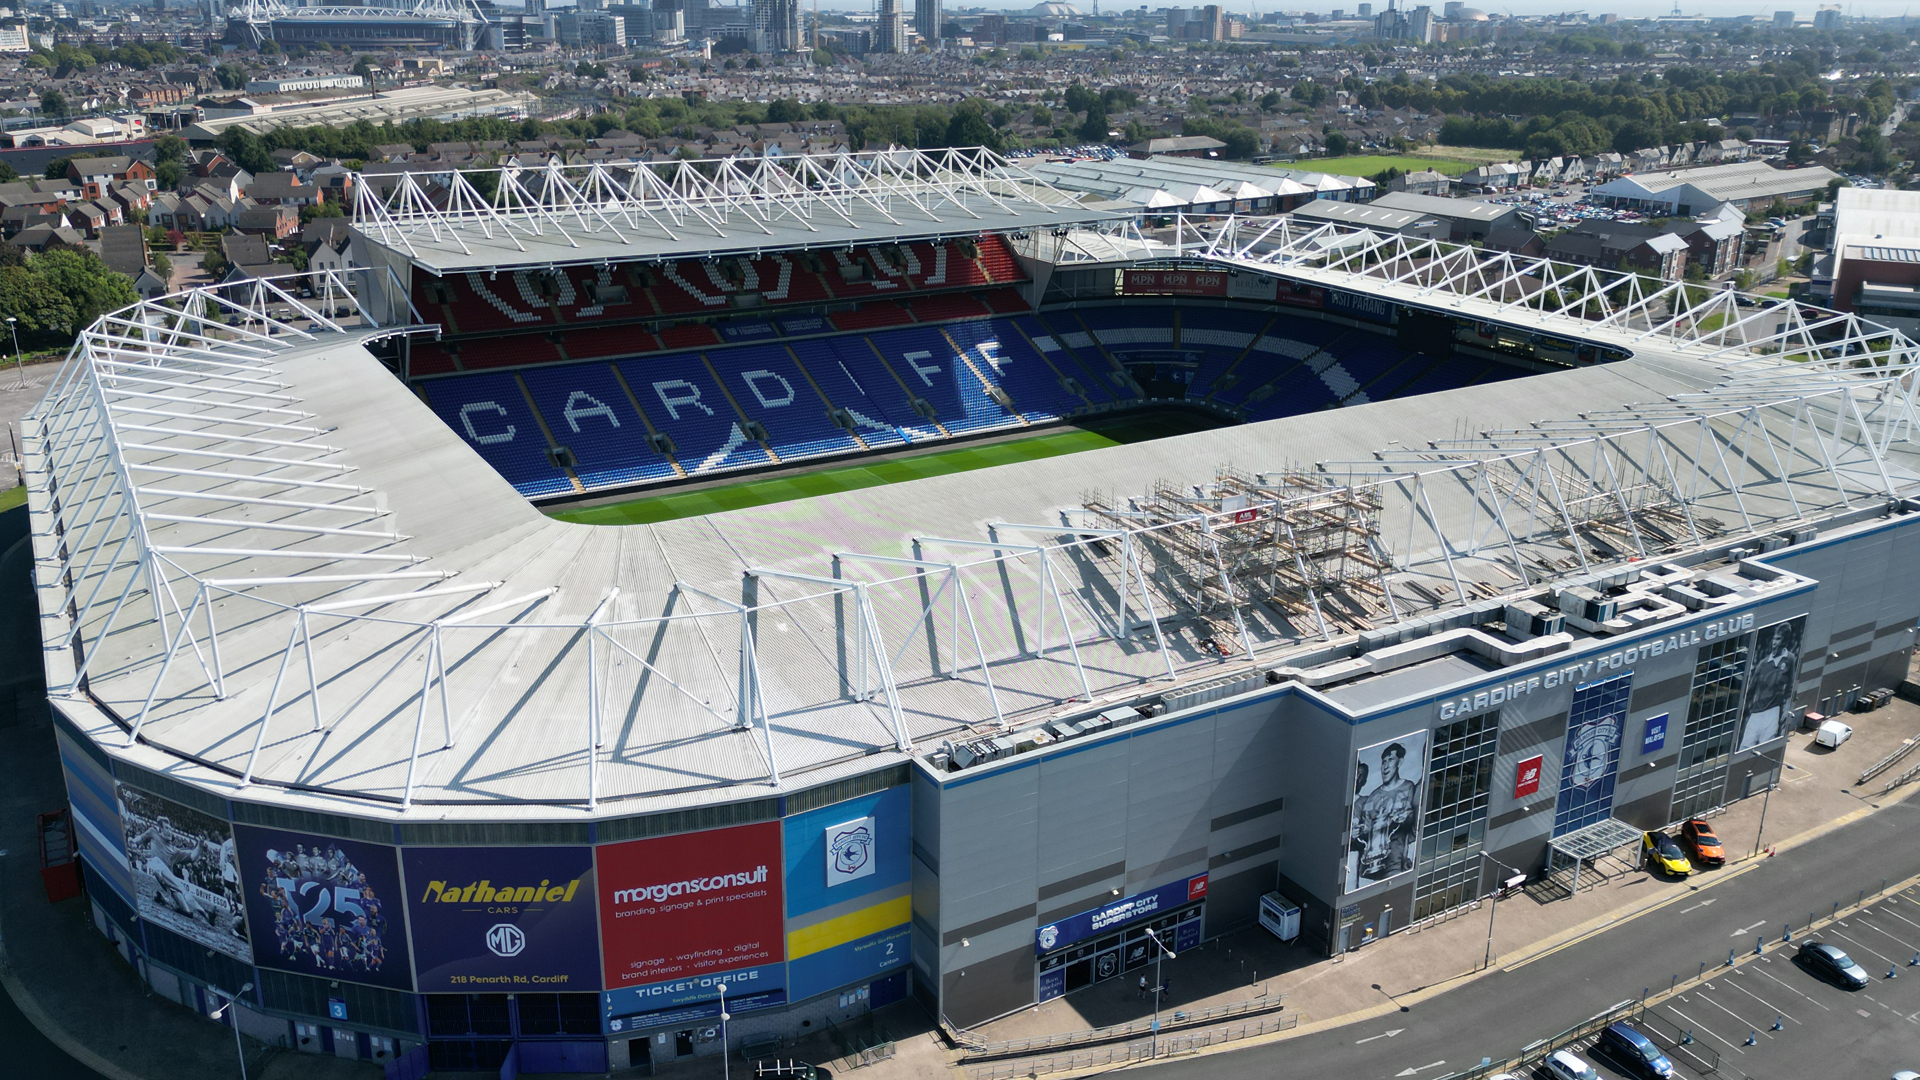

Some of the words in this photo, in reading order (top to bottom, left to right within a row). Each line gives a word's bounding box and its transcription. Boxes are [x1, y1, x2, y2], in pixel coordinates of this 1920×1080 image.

[1131, 275, 1155, 285] MPN
[1163, 275, 1187, 285] MPN
[1195, 276, 1220, 286] MPN
[1352, 295, 1386, 315] PAHANG
[459, 342, 1013, 445] CARDIFF
[1439, 676, 1541, 721] CARDIFF
[1543, 660, 1595, 690] CITY
[1596, 629, 1701, 674] FOOTBALL
[1704, 613, 1755, 642] CLUB
[421, 878, 581, 903] Nathaniel
[659, 899, 695, 914] signage
[696, 899, 704, 907] &
[705, 895, 724, 907] print
[725, 888, 768, 903] specialists
[487, 906, 519, 914] CARS
[1091, 902, 1136, 923] CARDIFF
[1135, 893, 1159, 908] CITY
[1091, 901, 1159, 931] SUPERSTORE
[489, 926, 523, 954] MG
[885, 942, 895, 955] 2
[621, 966, 648, 980] brand
[650, 964, 683, 976] interiors
[693, 958, 717, 969] visitor
[718, 951, 769, 966] experiences
[630, 957, 665, 970] signage
[675, 947, 723, 963] wayfinding
[733, 941, 760, 952] digital
[879, 957, 900, 968] Canton
[450, 975, 467, 984] 218
[470, 974, 511, 984] Penarth
[513, 974, 530, 984] Rd,
[531, 974, 569, 984] Cardiff
[635, 980, 695, 998] TICKET
[700, 970, 759, 988] OFFICE
[1704, 981, 1716, 990] 3
[1678, 994, 1689, 1003] 2
[333, 1005, 343, 1017] 3
[1564, 1043, 1584, 1056] P13
